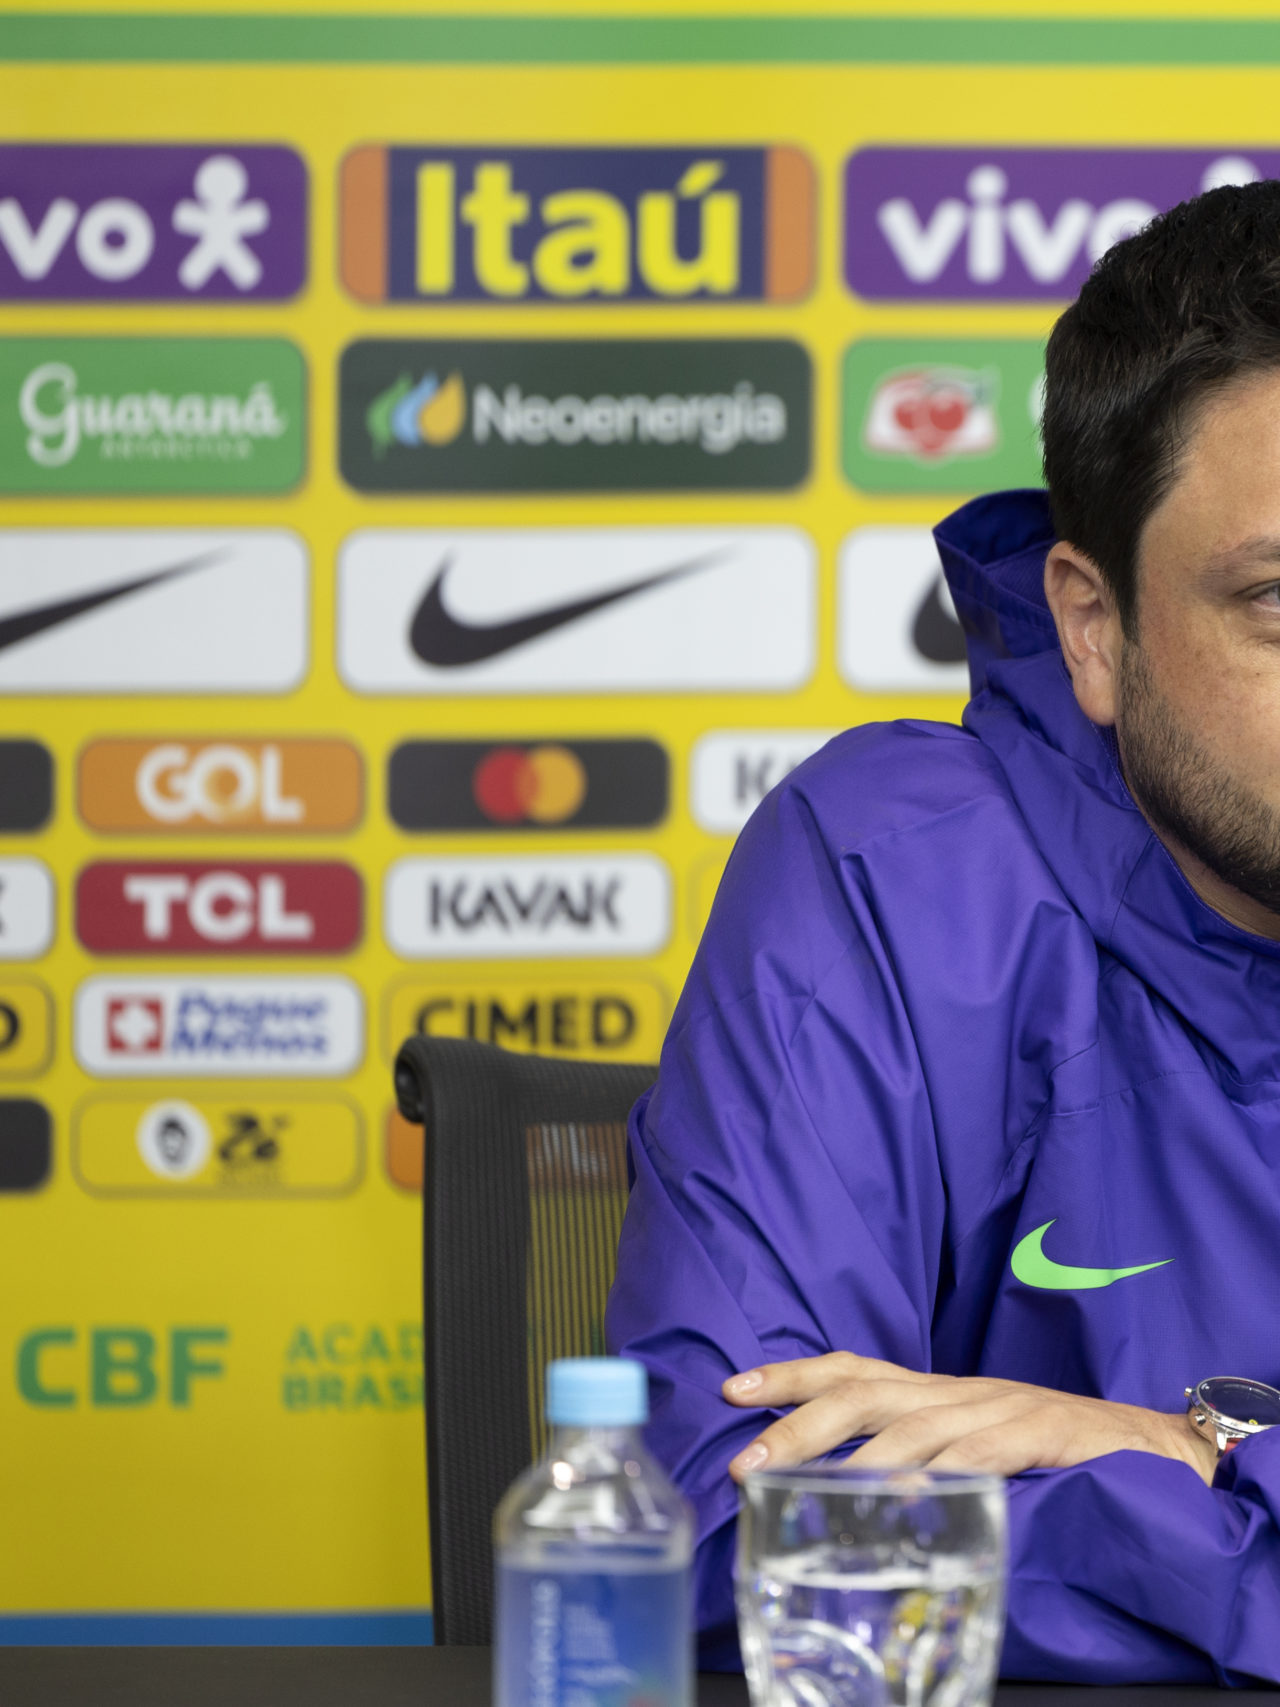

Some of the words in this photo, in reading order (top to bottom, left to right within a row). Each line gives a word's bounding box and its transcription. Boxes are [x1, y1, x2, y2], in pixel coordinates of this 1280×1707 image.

[417, 162, 739, 297] Itaú
[20, 362, 286, 466] Guaraná
[473, 383, 786, 453] Neoenergia
[137, 746, 304, 822] GOL
[125, 873, 313, 940] TCL
[428, 877, 621, 934] KAVAK
[413, 996, 637, 1052] CIMED
[15, 1326, 229, 1410] CBF
